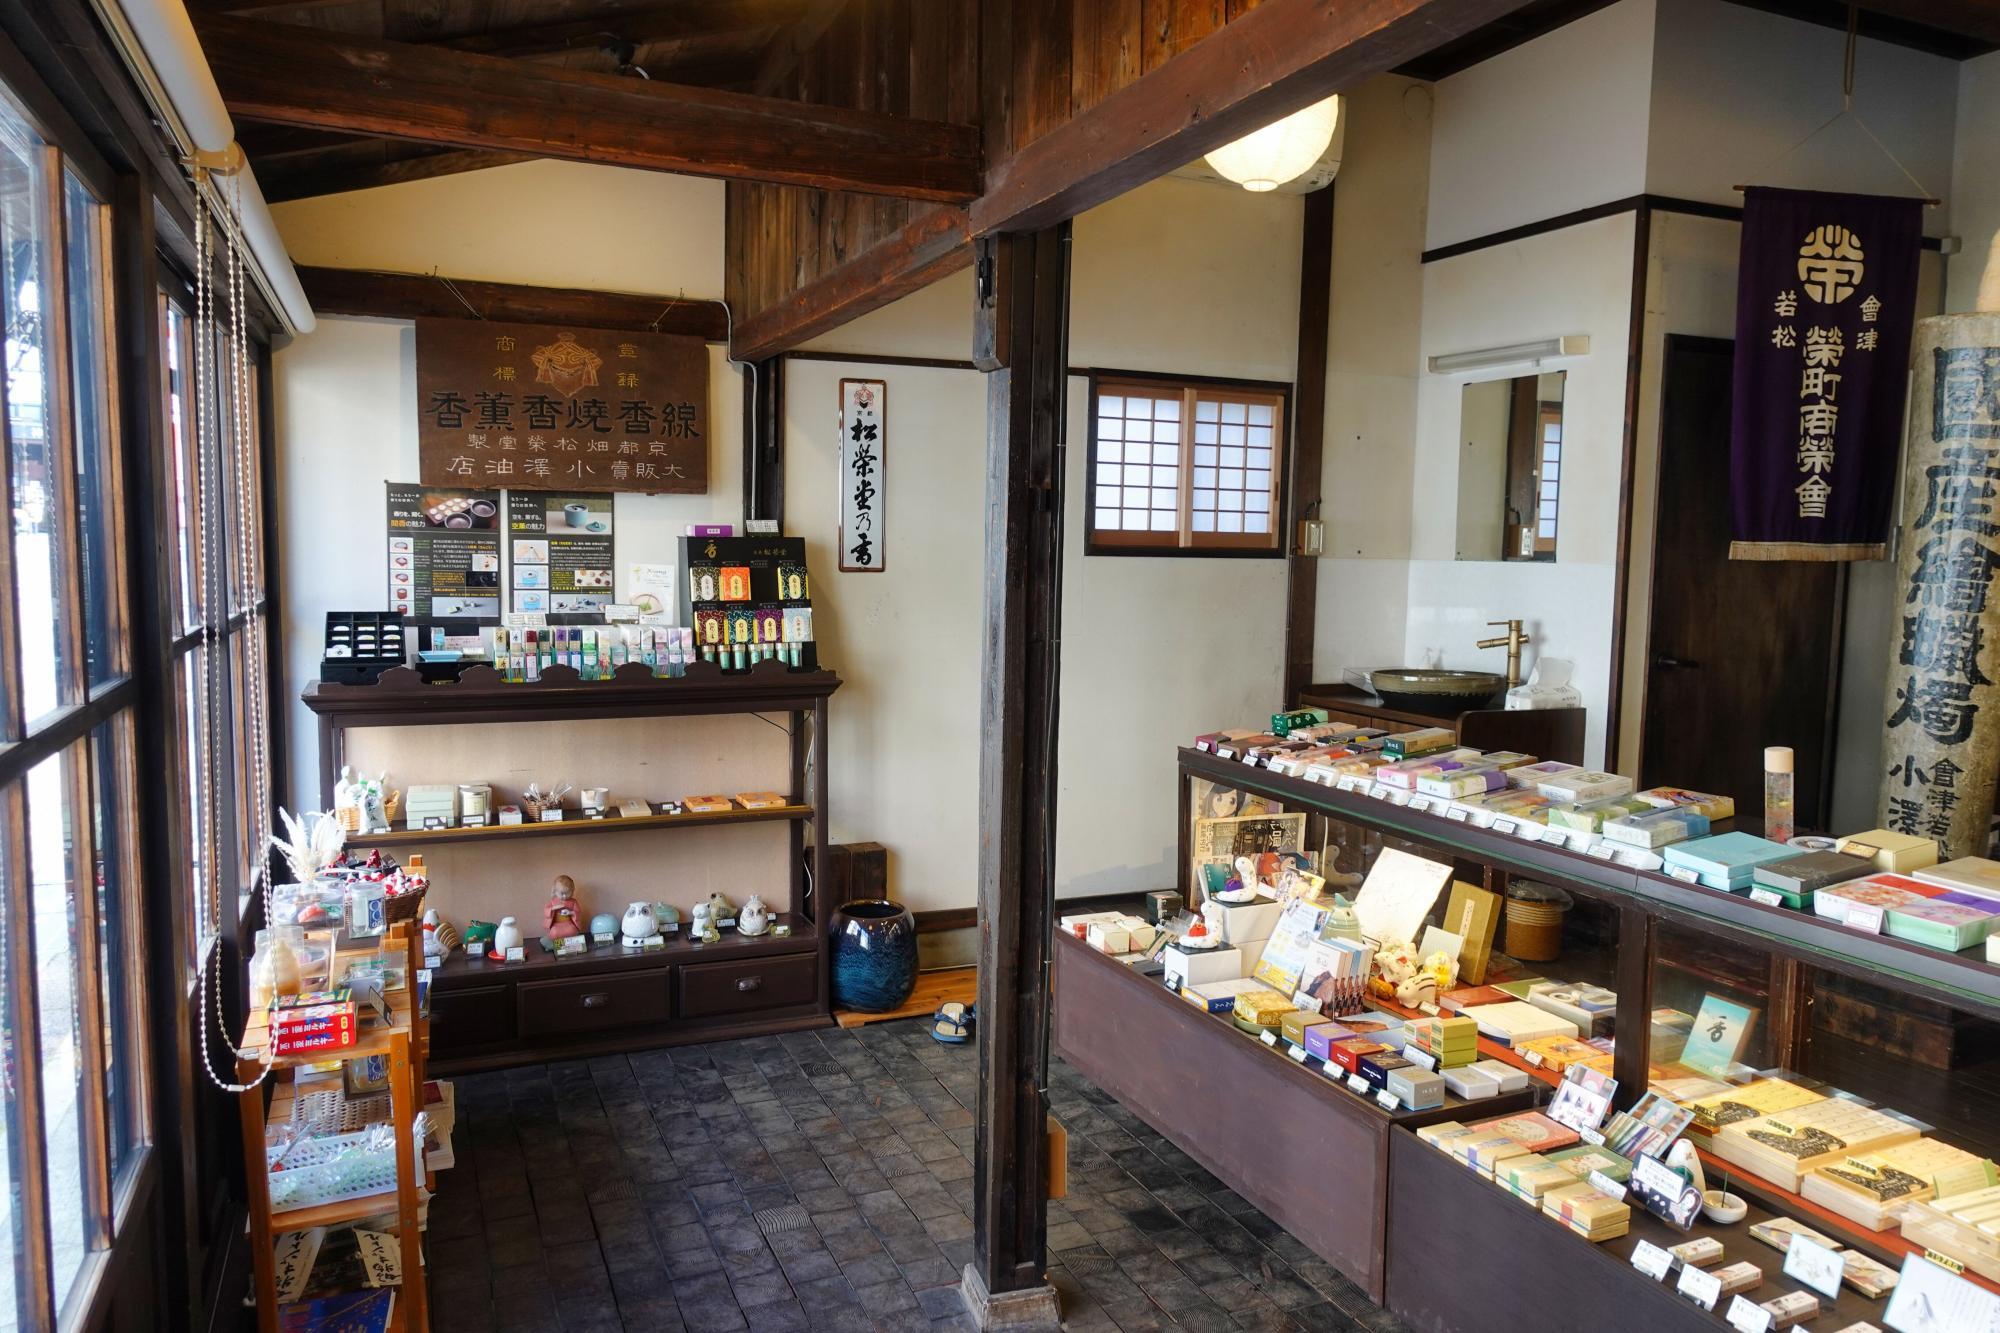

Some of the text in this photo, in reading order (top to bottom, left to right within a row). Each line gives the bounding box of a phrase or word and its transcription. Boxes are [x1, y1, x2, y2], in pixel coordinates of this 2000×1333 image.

[1771, 291, 1798, 348] 若松
[1855, 294, 1882, 351] 會津
[492, 335, 517, 383] 商標
